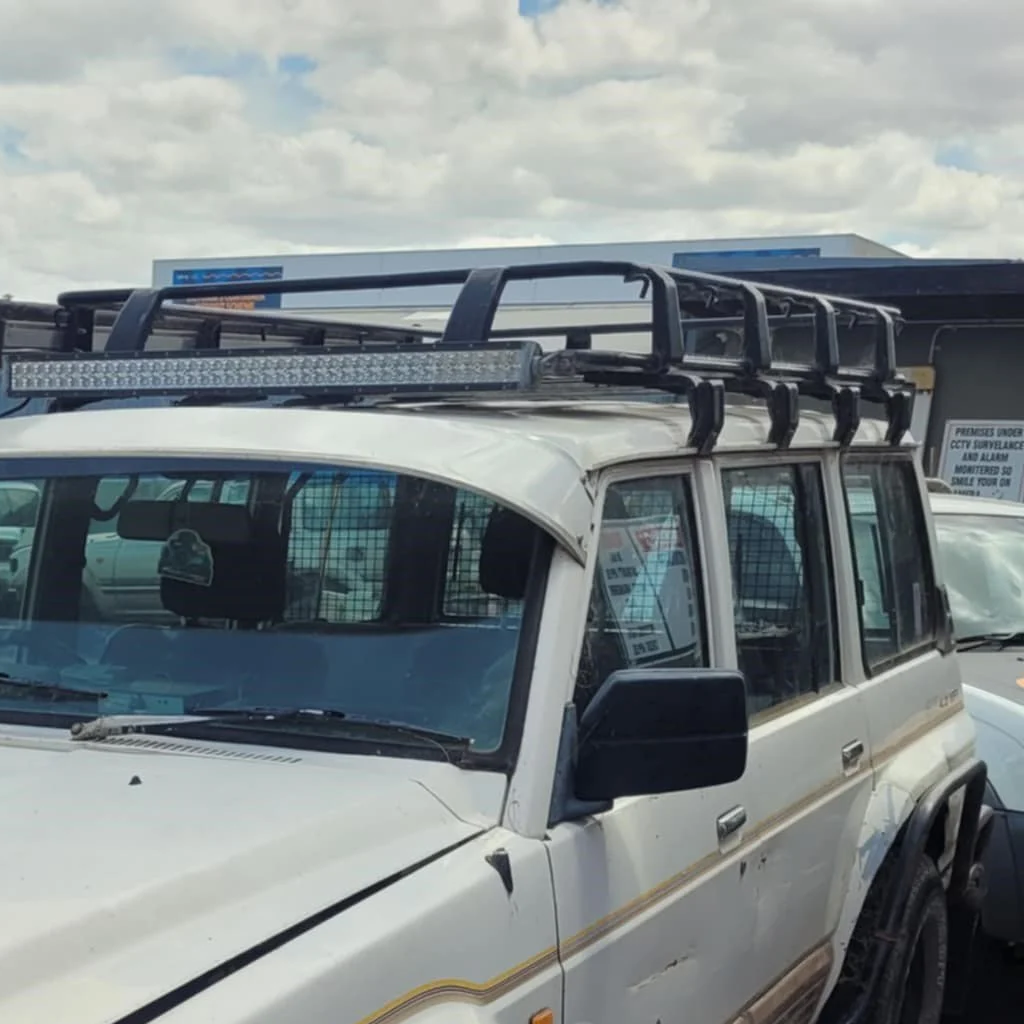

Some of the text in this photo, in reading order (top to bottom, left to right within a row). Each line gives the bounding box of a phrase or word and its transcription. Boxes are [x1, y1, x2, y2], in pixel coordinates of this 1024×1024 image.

[955, 427, 1023, 437] PREMISES UNDER
[950, 440, 971, 449] CCTV
[962, 452, 1009, 462] AND ALARM
[951, 476, 1012, 488] SMILE YOUR ON
